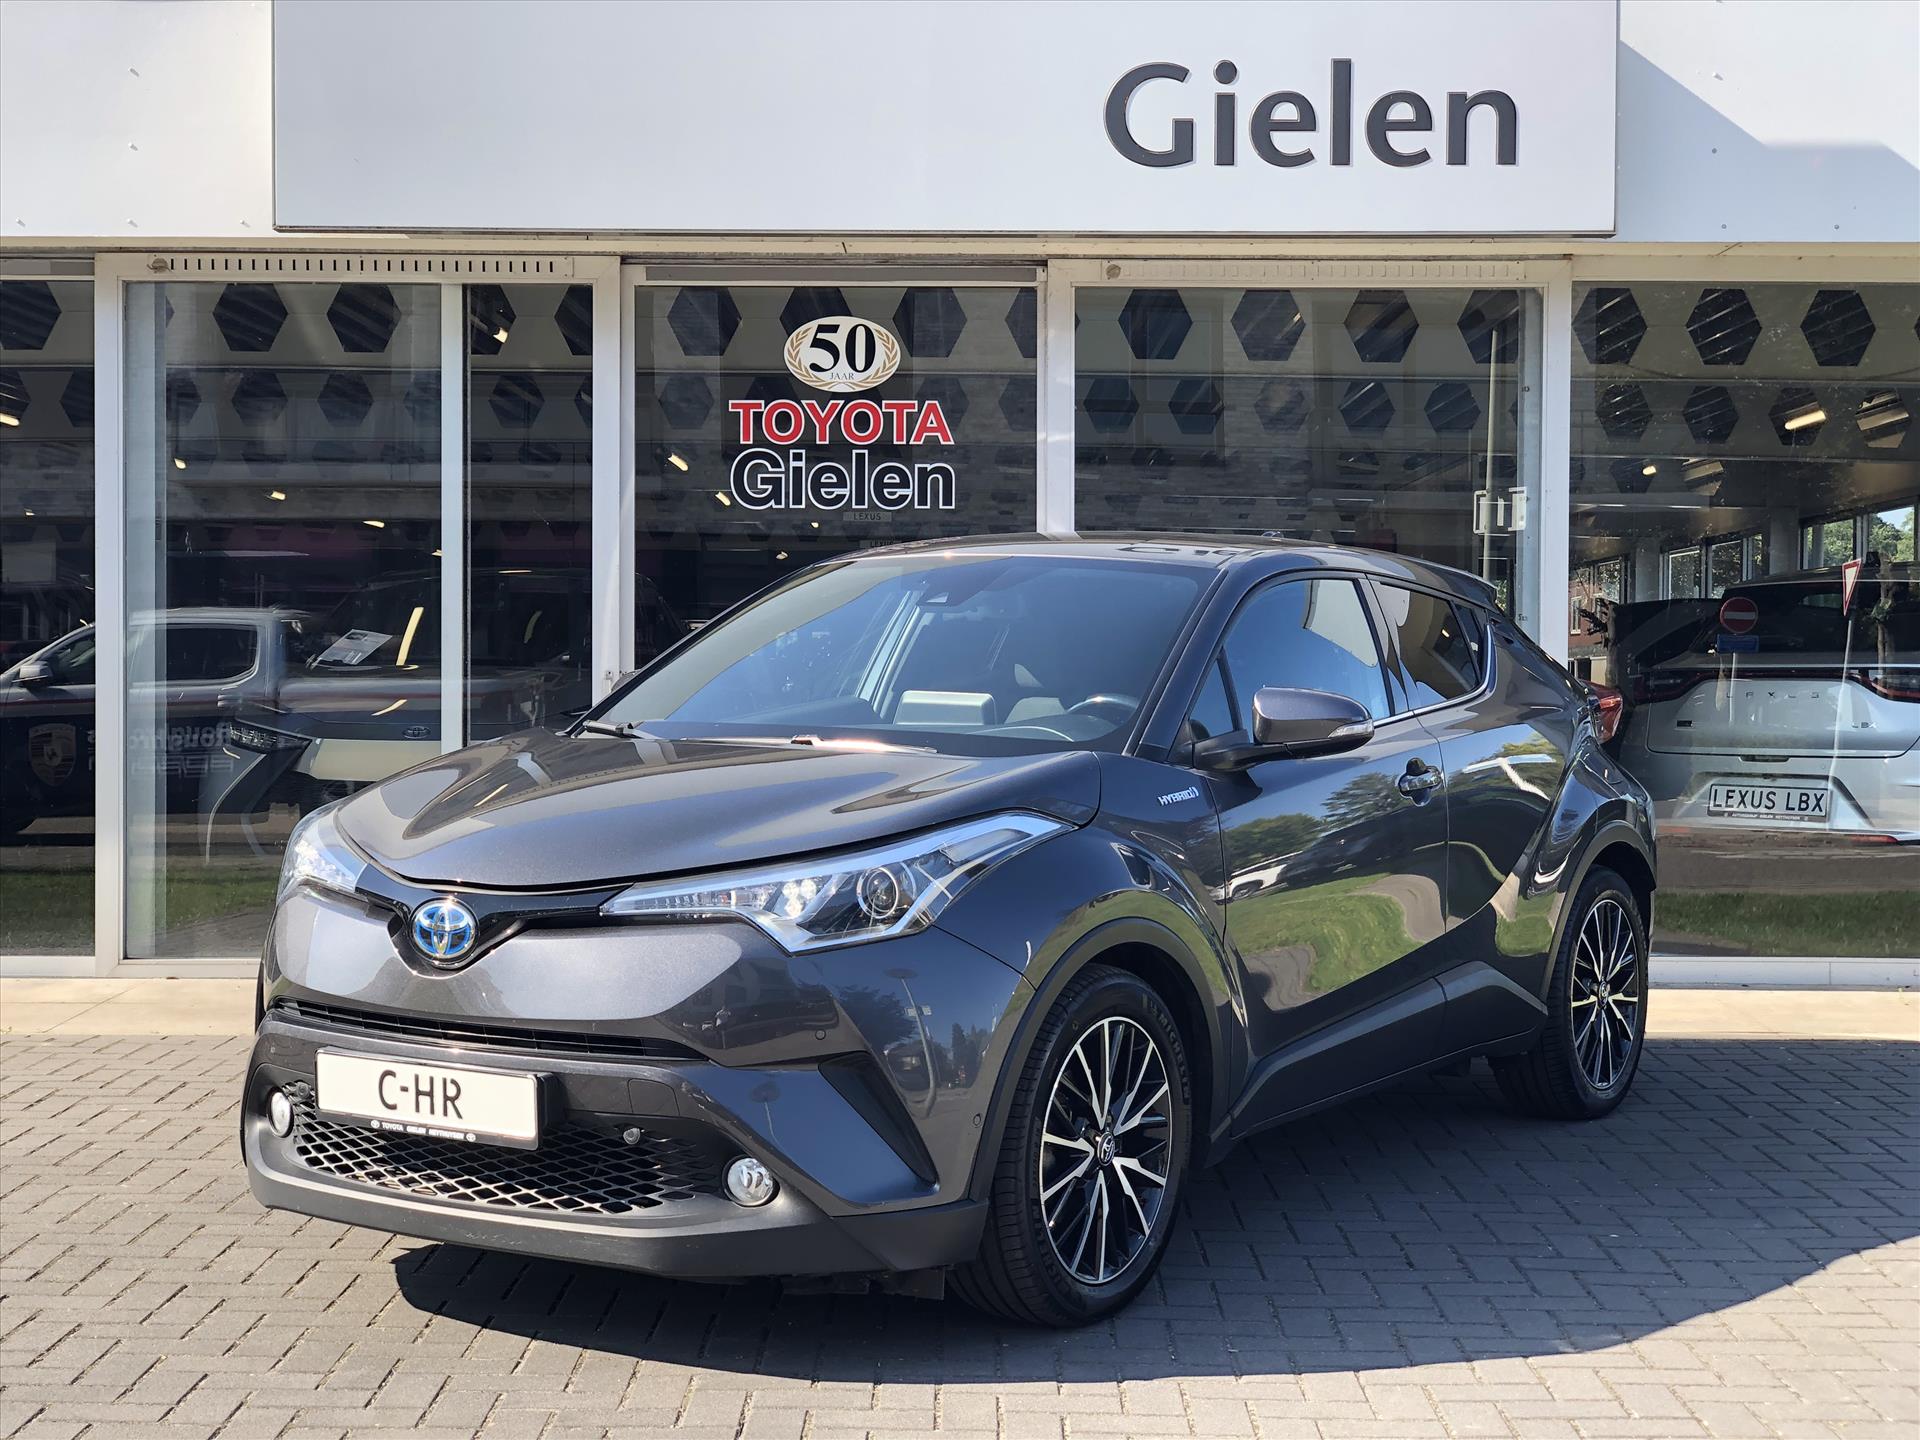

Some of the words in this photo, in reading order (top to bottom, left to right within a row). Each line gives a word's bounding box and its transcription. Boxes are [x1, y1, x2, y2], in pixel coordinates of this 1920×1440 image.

[1103, 58, 1517, 167] Gielen
[809, 323, 876, 373] 50
[829, 372, 855, 380] JAAR
[729, 399, 954, 445] TOYOTA
[730, 448, 955, 510] Gielen
[853, 512, 882, 520] LEXUS
[1157, 787, 1197, 806] HYBRID
[1713, 788, 1777, 810] LEXUS
[1785, 792, 1825, 812] LBX
[378, 1069, 463, 1119] C-HR
[381, 1121, 404, 1131] TOYOTA
